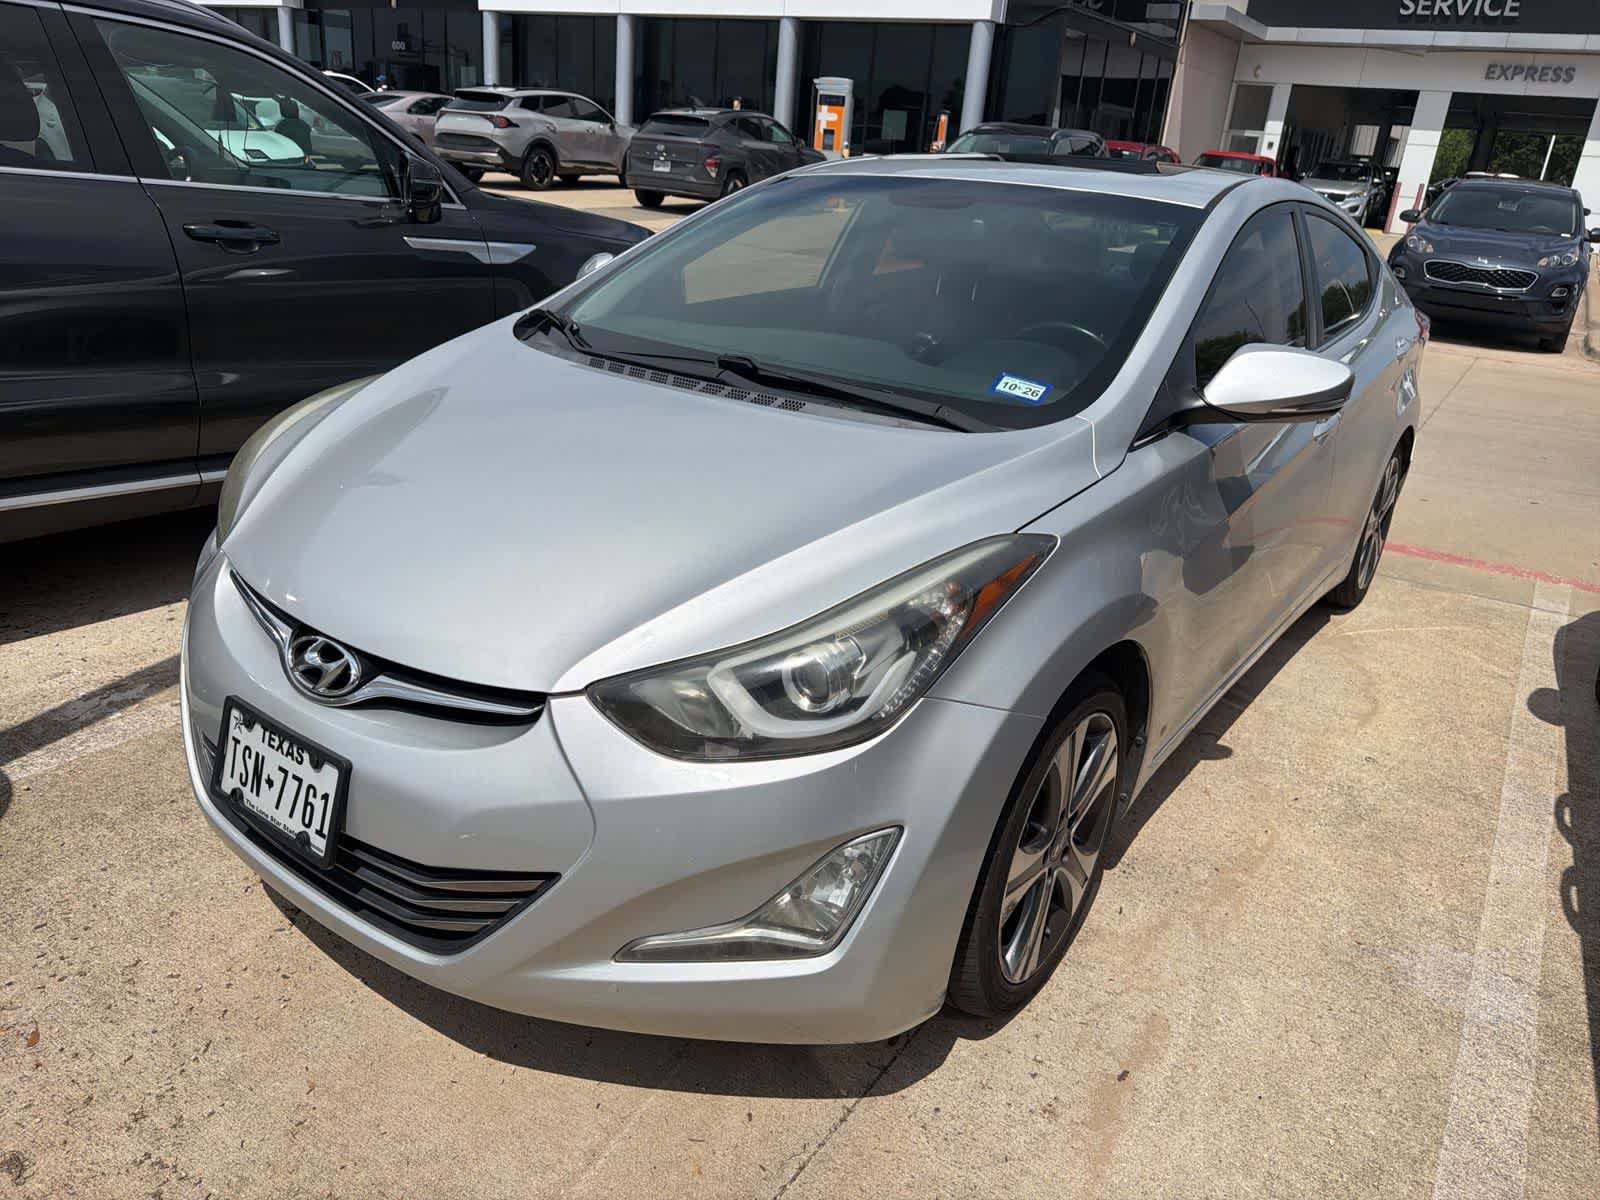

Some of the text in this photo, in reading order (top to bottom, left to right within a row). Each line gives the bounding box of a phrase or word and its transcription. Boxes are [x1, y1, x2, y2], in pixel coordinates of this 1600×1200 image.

[1399, 0, 1520, 17] SERVICE
[1484, 63, 1577, 84] EXPRESS
[1002, 382, 1041, 398] 10 26
[260, 727, 305, 766] TEXAS
[269, 814, 282, 827] Star
